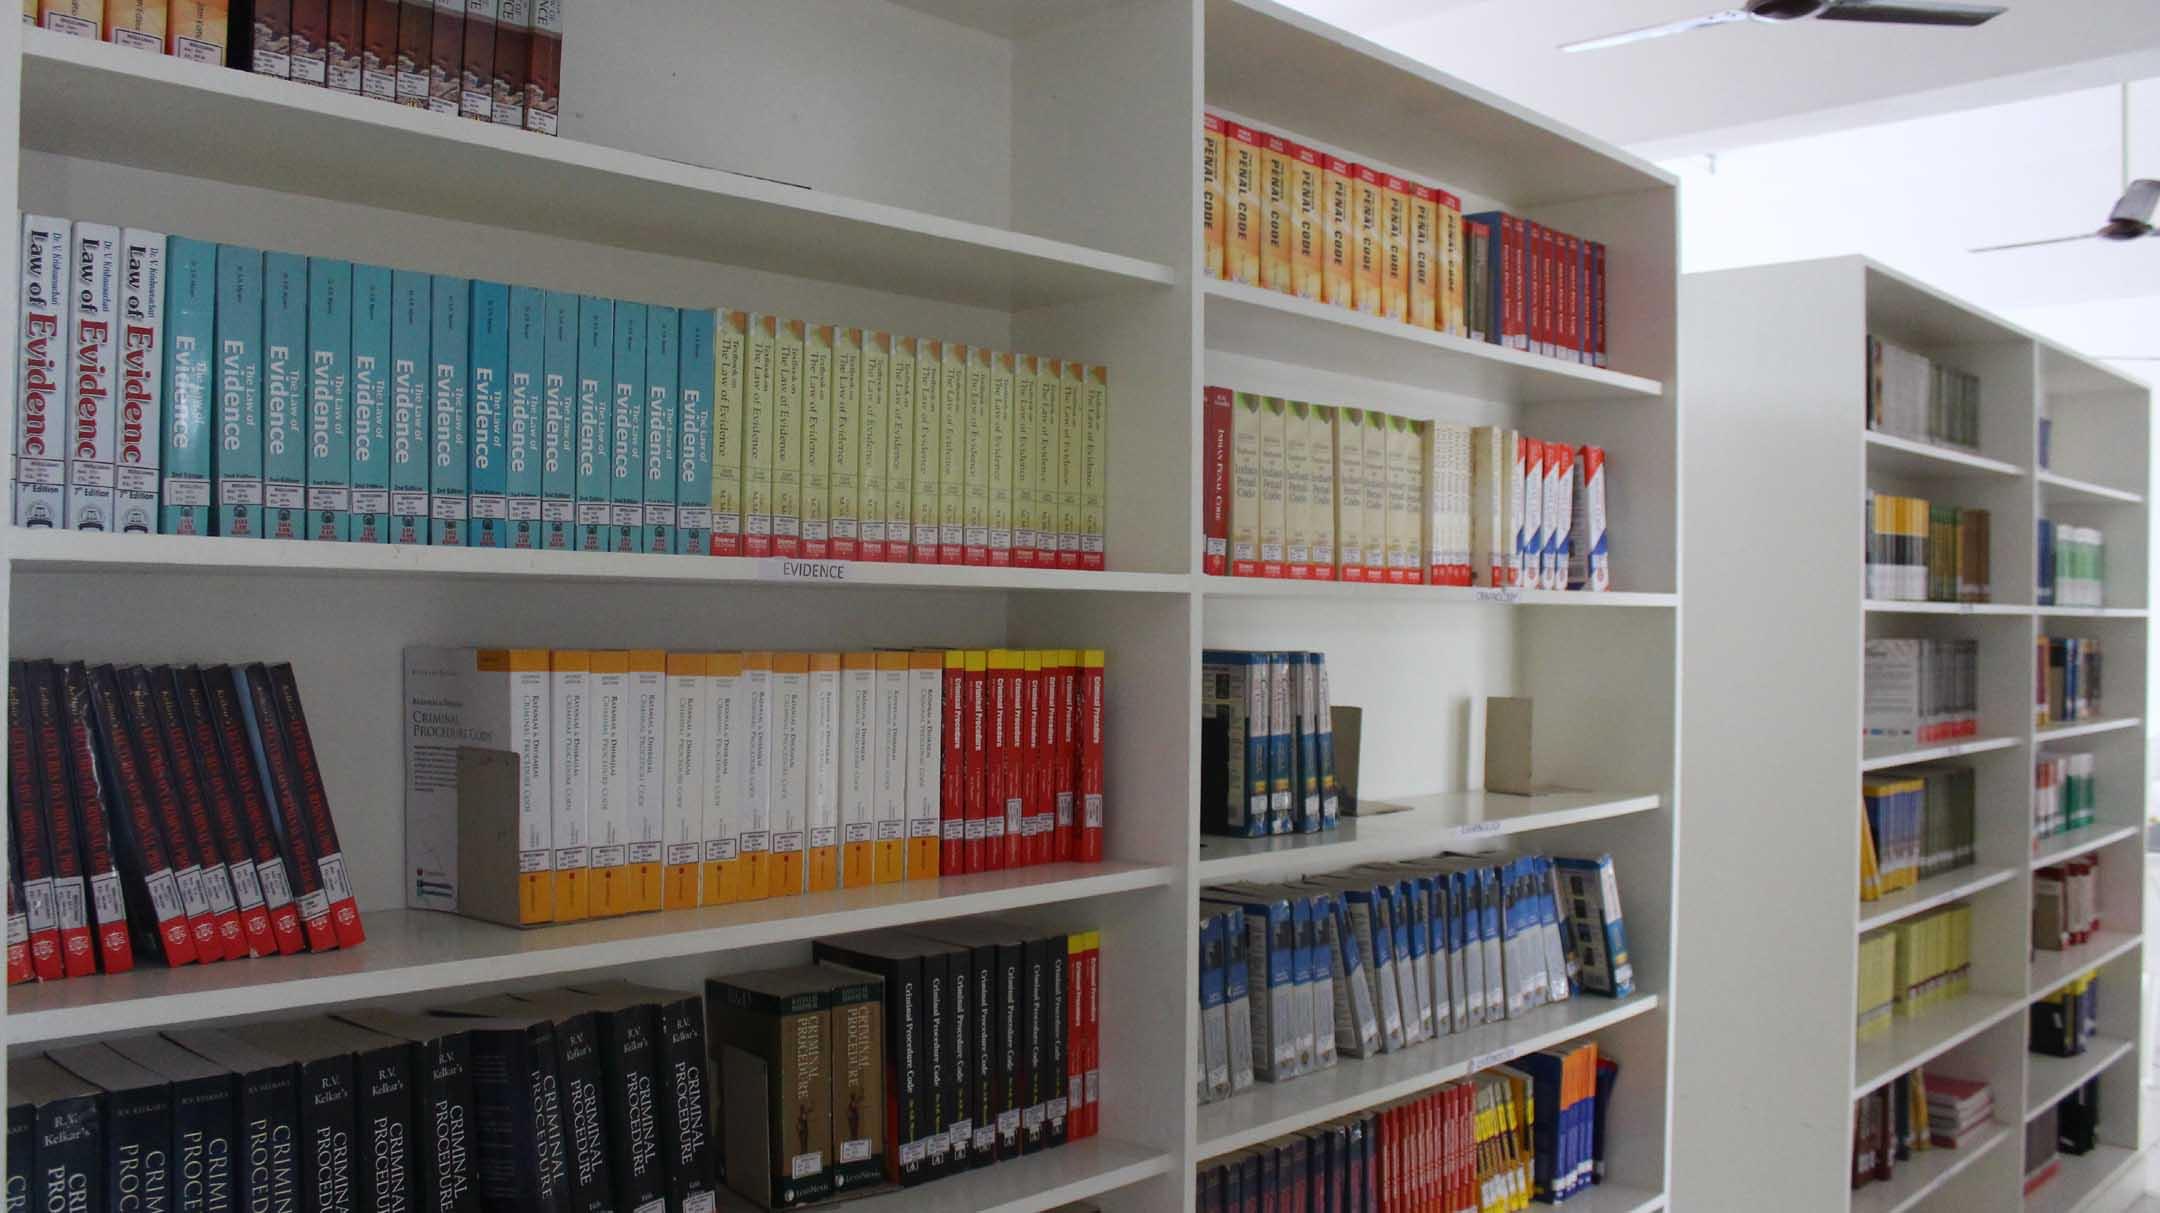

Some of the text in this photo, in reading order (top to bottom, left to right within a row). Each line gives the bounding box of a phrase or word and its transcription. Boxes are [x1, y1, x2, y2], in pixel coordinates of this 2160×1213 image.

[1204, 138, 1214, 230] PENAL CODE
[1239, 150, 1248, 240] PENAL CODE
[1271, 160, 1280, 248] PENAL CODE
[1302, 170, 1310, 256] PENAL CODE
[30, 230, 49, 274] Law
[1334, 181, 1343, 266] PENAL CODE
[1363, 190, 1372, 272] PENAL CODE
[1418, 206, 1426, 285] PENAL CODE
[82, 238, 100, 282] Law
[128, 245, 146, 288] Law
[29, 282, 47, 306] of
[80, 290, 98, 313] of
[128, 296, 144, 319] of
[27, 312, 58, 456] Evidenc
[78, 320, 108, 459] Evidenc
[123, 324, 154, 463] Evidenc
[174, 336, 195, 448] Evidence
[224, 340, 244, 450] Evidence
[246, 364, 256, 384] The
[246, 388, 256, 411] Law
[270, 346, 289, 454] Evidence
[290, 370, 300, 390] The
[290, 394, 300, 416] Law
[314, 350, 334, 458] Evidence
[335, 374, 344, 394] The
[376, 380, 384, 398] The
[415, 384, 424, 402] The
[455, 388, 464, 406] The
[493, 390, 501, 410] The
[530, 395, 538, 413] The
[720, 340, 731, 456] The Law of Evidence
[780, 347, 790, 462] The Law of Evidence
[335, 398, 344, 420] Law
[356, 356, 375, 461] Evidence
[376, 402, 384, 424] Law
[395, 360, 413, 464] Evidence
[415, 406, 424, 427] Law
[436, 364, 454, 466] Evidence
[455, 410, 464, 431] Law
[476, 368, 492, 470] Evidence
[493, 412, 501, 434] Law
[512, 373, 529, 472] Evidence
[530, 416, 538, 437] Law
[546, 374, 563, 472] Evidence
[564, 397, 572, 414] The
[564, 418, 572, 437] Law
[580, 379, 598, 476] Evidence
[616, 384, 632, 478] Evidence
[649, 386, 666, 480] Evidence
[683, 390, 700, 481] Evidence
[1216, 464, 1224, 491] PENAL
[784, 562, 844, 578] EVIDENCE
[904, 983, 914, 1021] Criminal
[379, 1066, 396, 1080] R.V.
[433, 1063, 462, 1080] Kelkar's
[438, 1051, 454, 1064] R.V.
[906, 1024, 914, 1069] Procedure
[314, 1089, 348, 1105] Kelkar's
[322, 1078, 340, 1089] R.V.
[372, 1080, 404, 1096] Kelkar's
[676, 1062, 693, 1165] PROCEDURE
[687, 1066, 704, 1152] CRIMINAL
[44, 1128, 91, 1146] Kelkar's
[54, 1111, 79, 1128] R.V.
[532, 1070, 552, 1200] PROCEDURE
[544, 1075, 564, 1184] CRIMINAL
[571, 1080, 592, 1186] PROCEDURE
[584, 1083, 602, 1172] CRIMINAL
[627, 1072, 645, 1176] PROCEDURE
[639, 1076, 656, 1164] CRIMINAL
[436, 1100, 453, 1213] PROCEDURE
[450, 1105, 468, 1198] CRIMINAL
